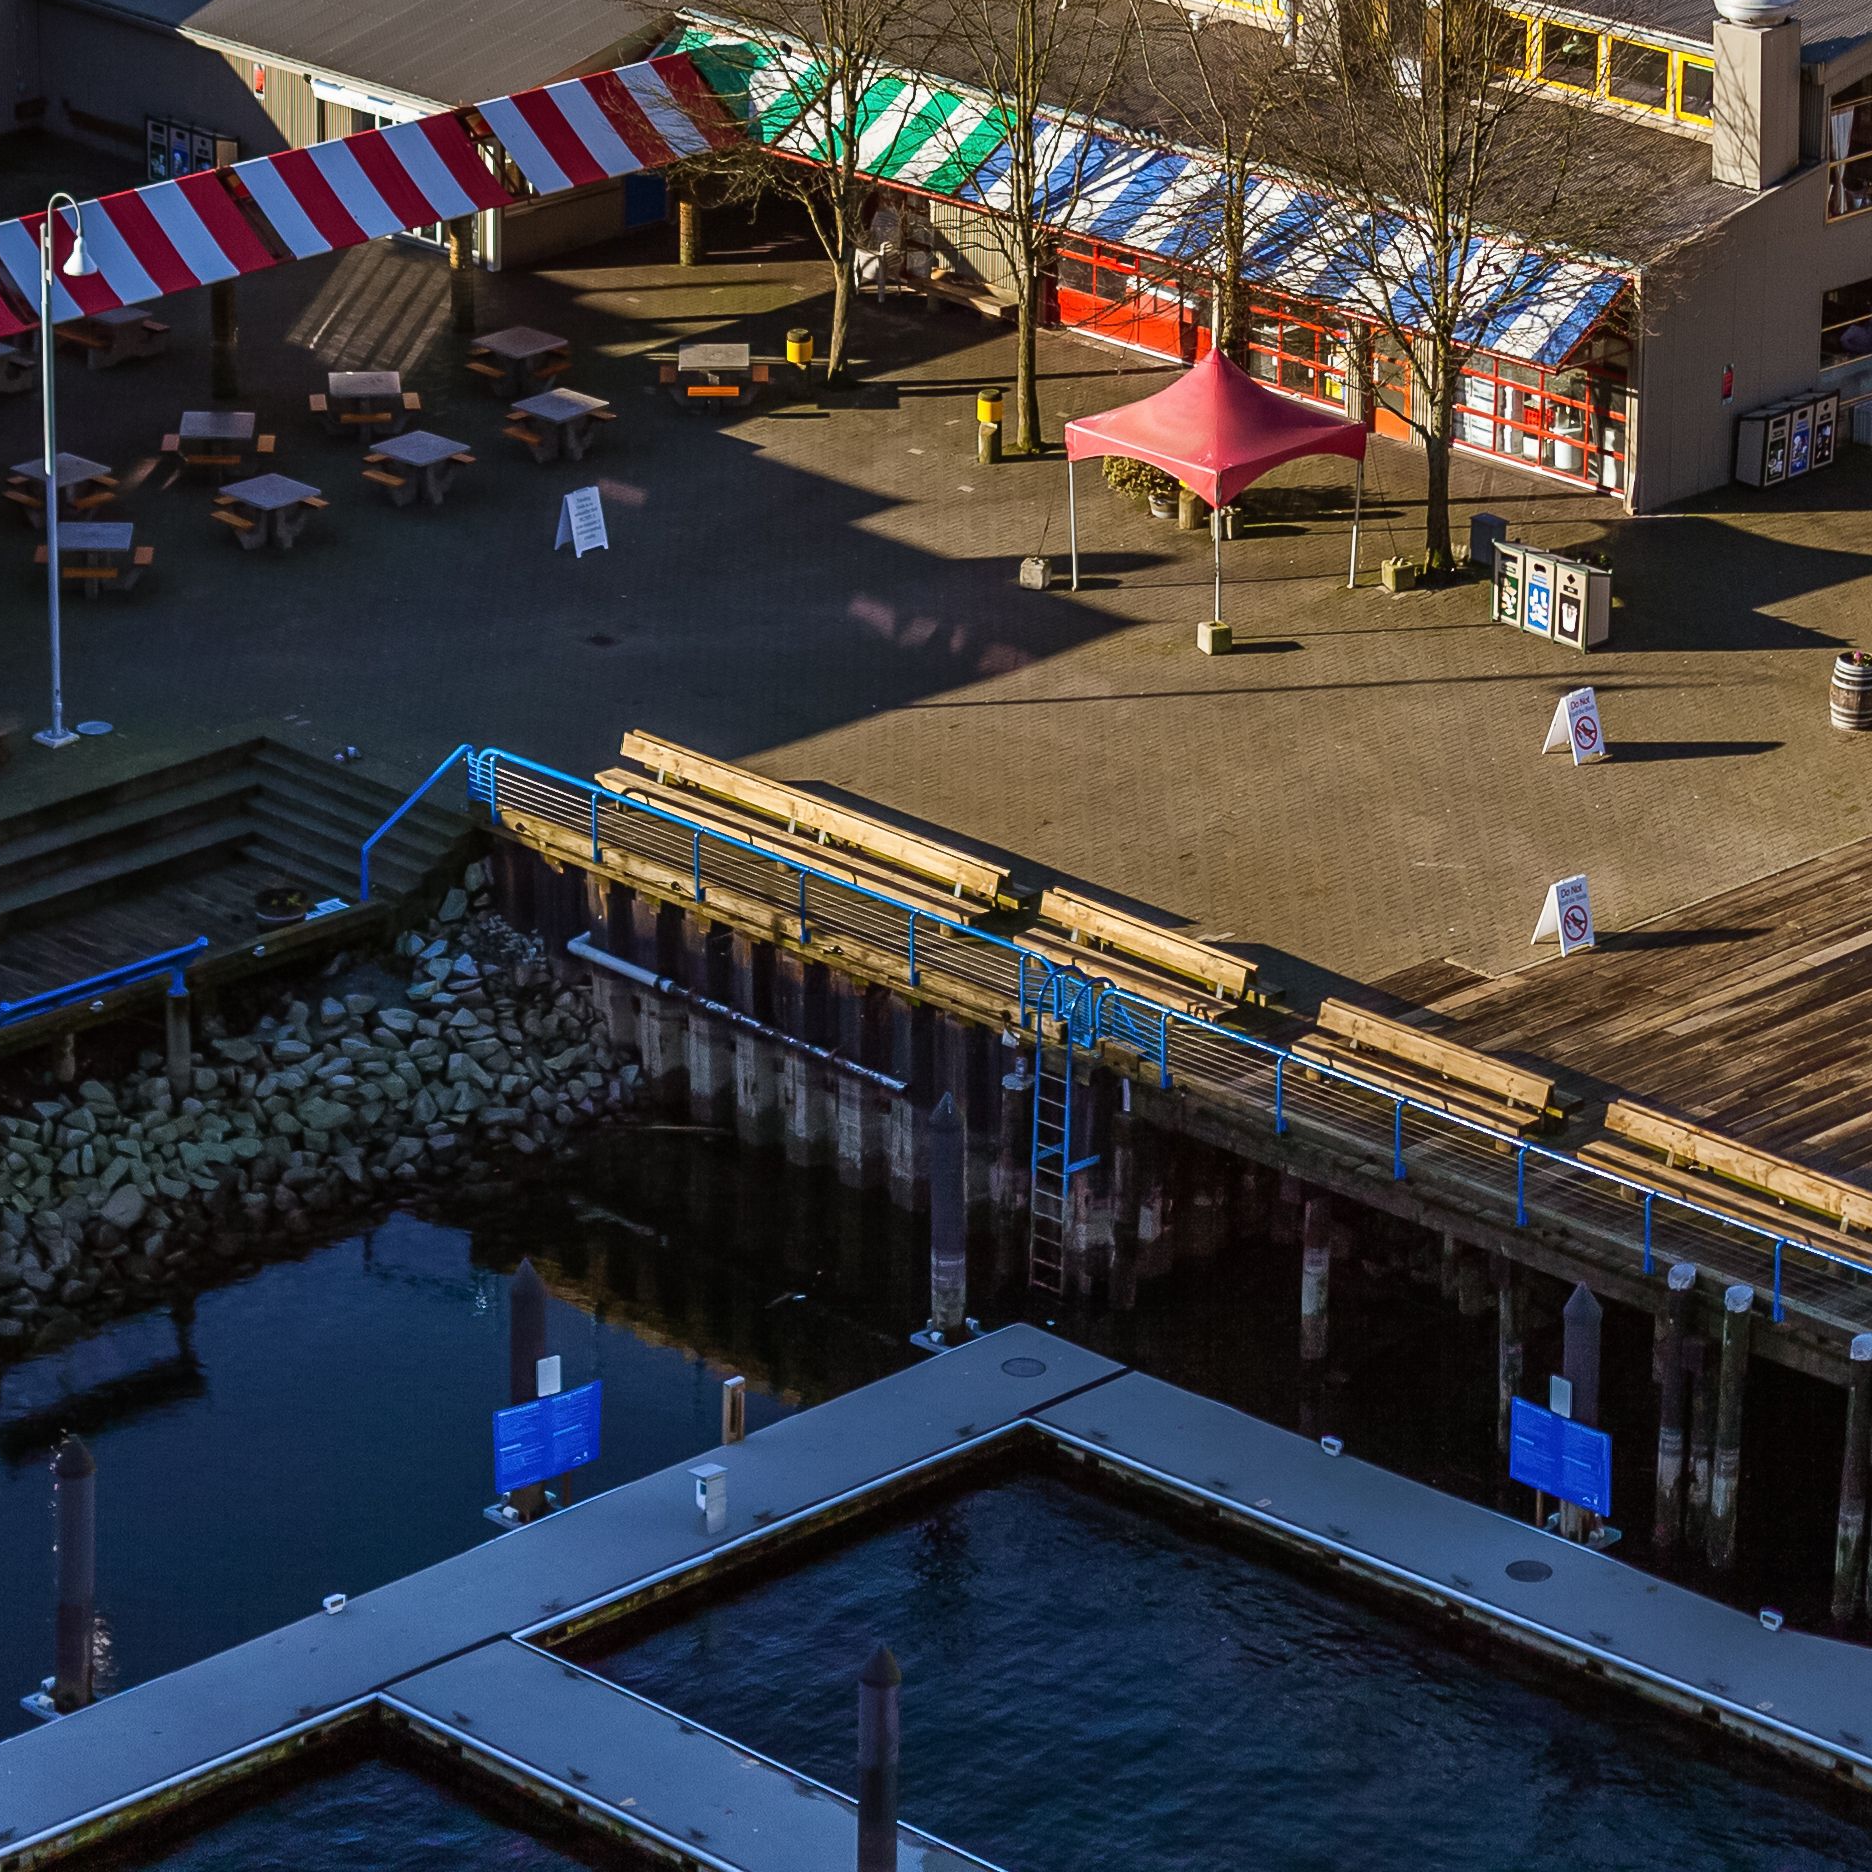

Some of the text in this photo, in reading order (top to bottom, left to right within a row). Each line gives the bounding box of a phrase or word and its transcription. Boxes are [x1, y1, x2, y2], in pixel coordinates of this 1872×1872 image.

[1570, 696, 1591, 710] Do Not
[1560, 884, 1583, 898] Do Not
